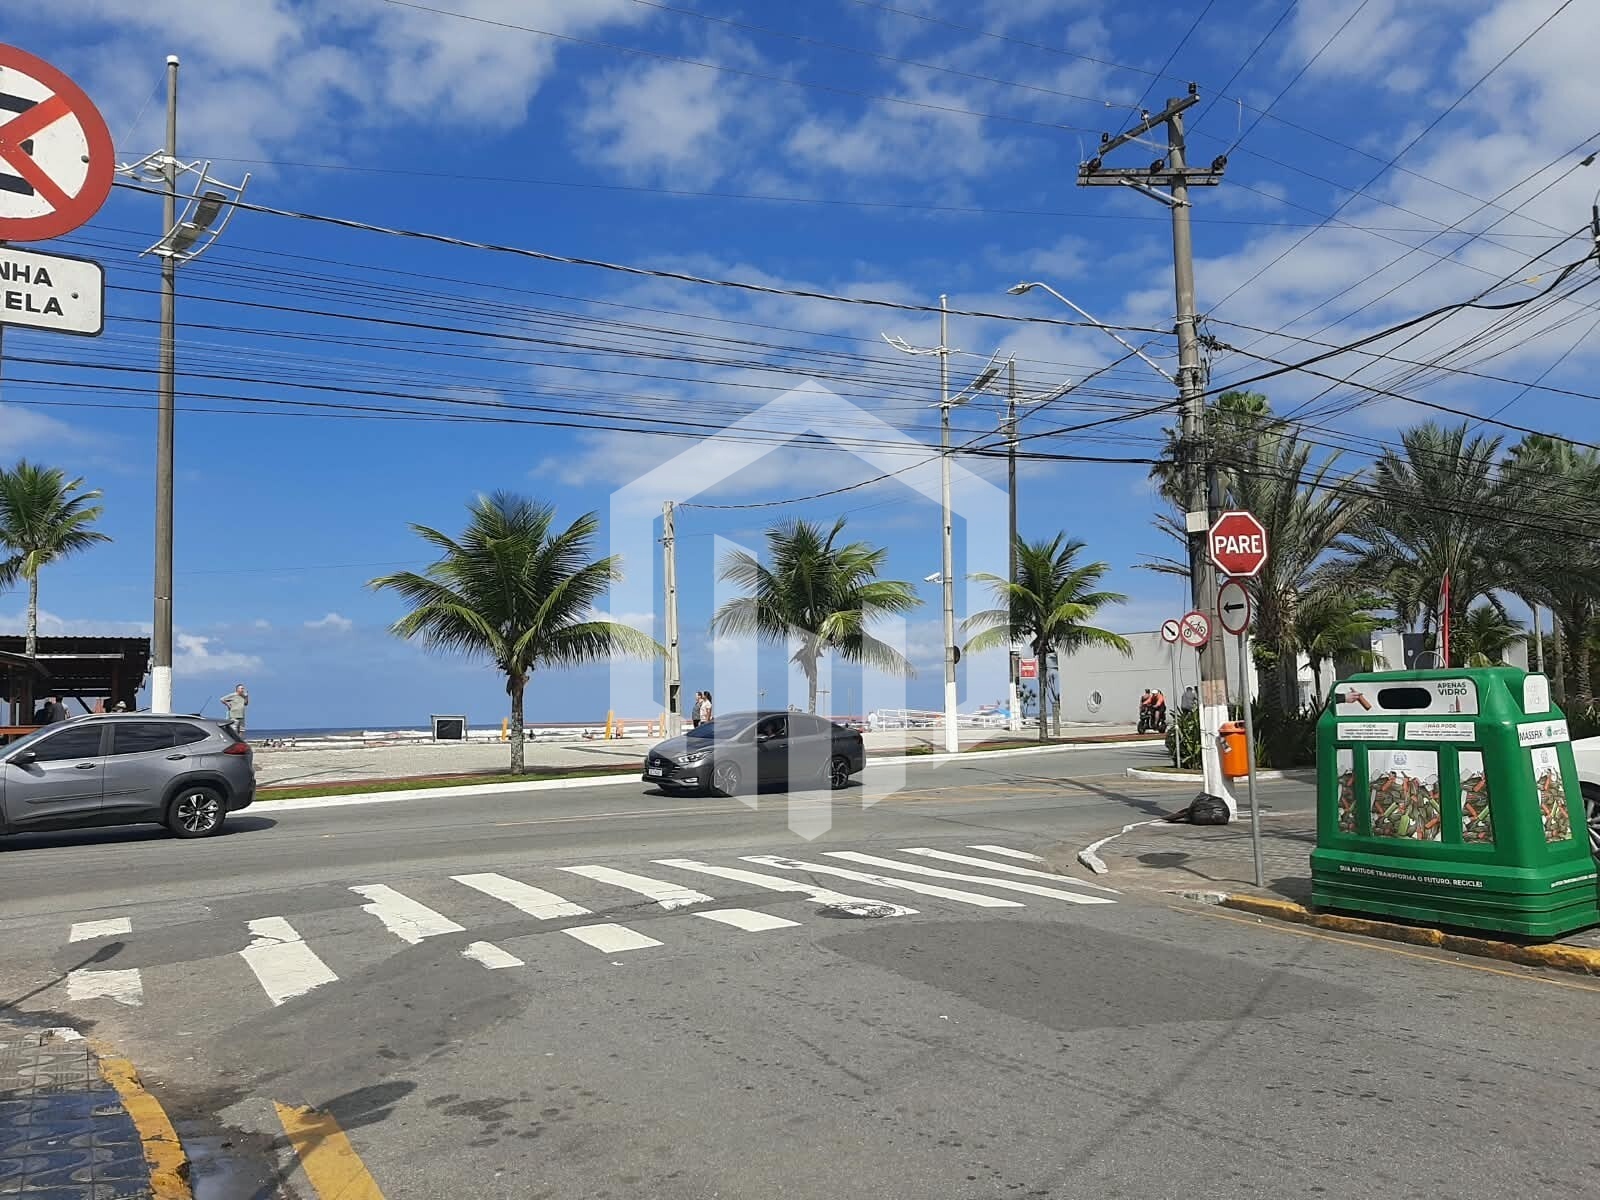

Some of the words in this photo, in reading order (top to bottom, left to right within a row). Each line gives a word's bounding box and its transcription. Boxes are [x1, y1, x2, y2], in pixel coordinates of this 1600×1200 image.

[0, 290, 64, 317] ELA
[1214, 534, 1262, 555] PARE
[1437, 681, 1467, 689] APENAS
[1438, 688, 1468, 696] VIDRO
[1375, 870, 1417, 881] TRANSFORMA
